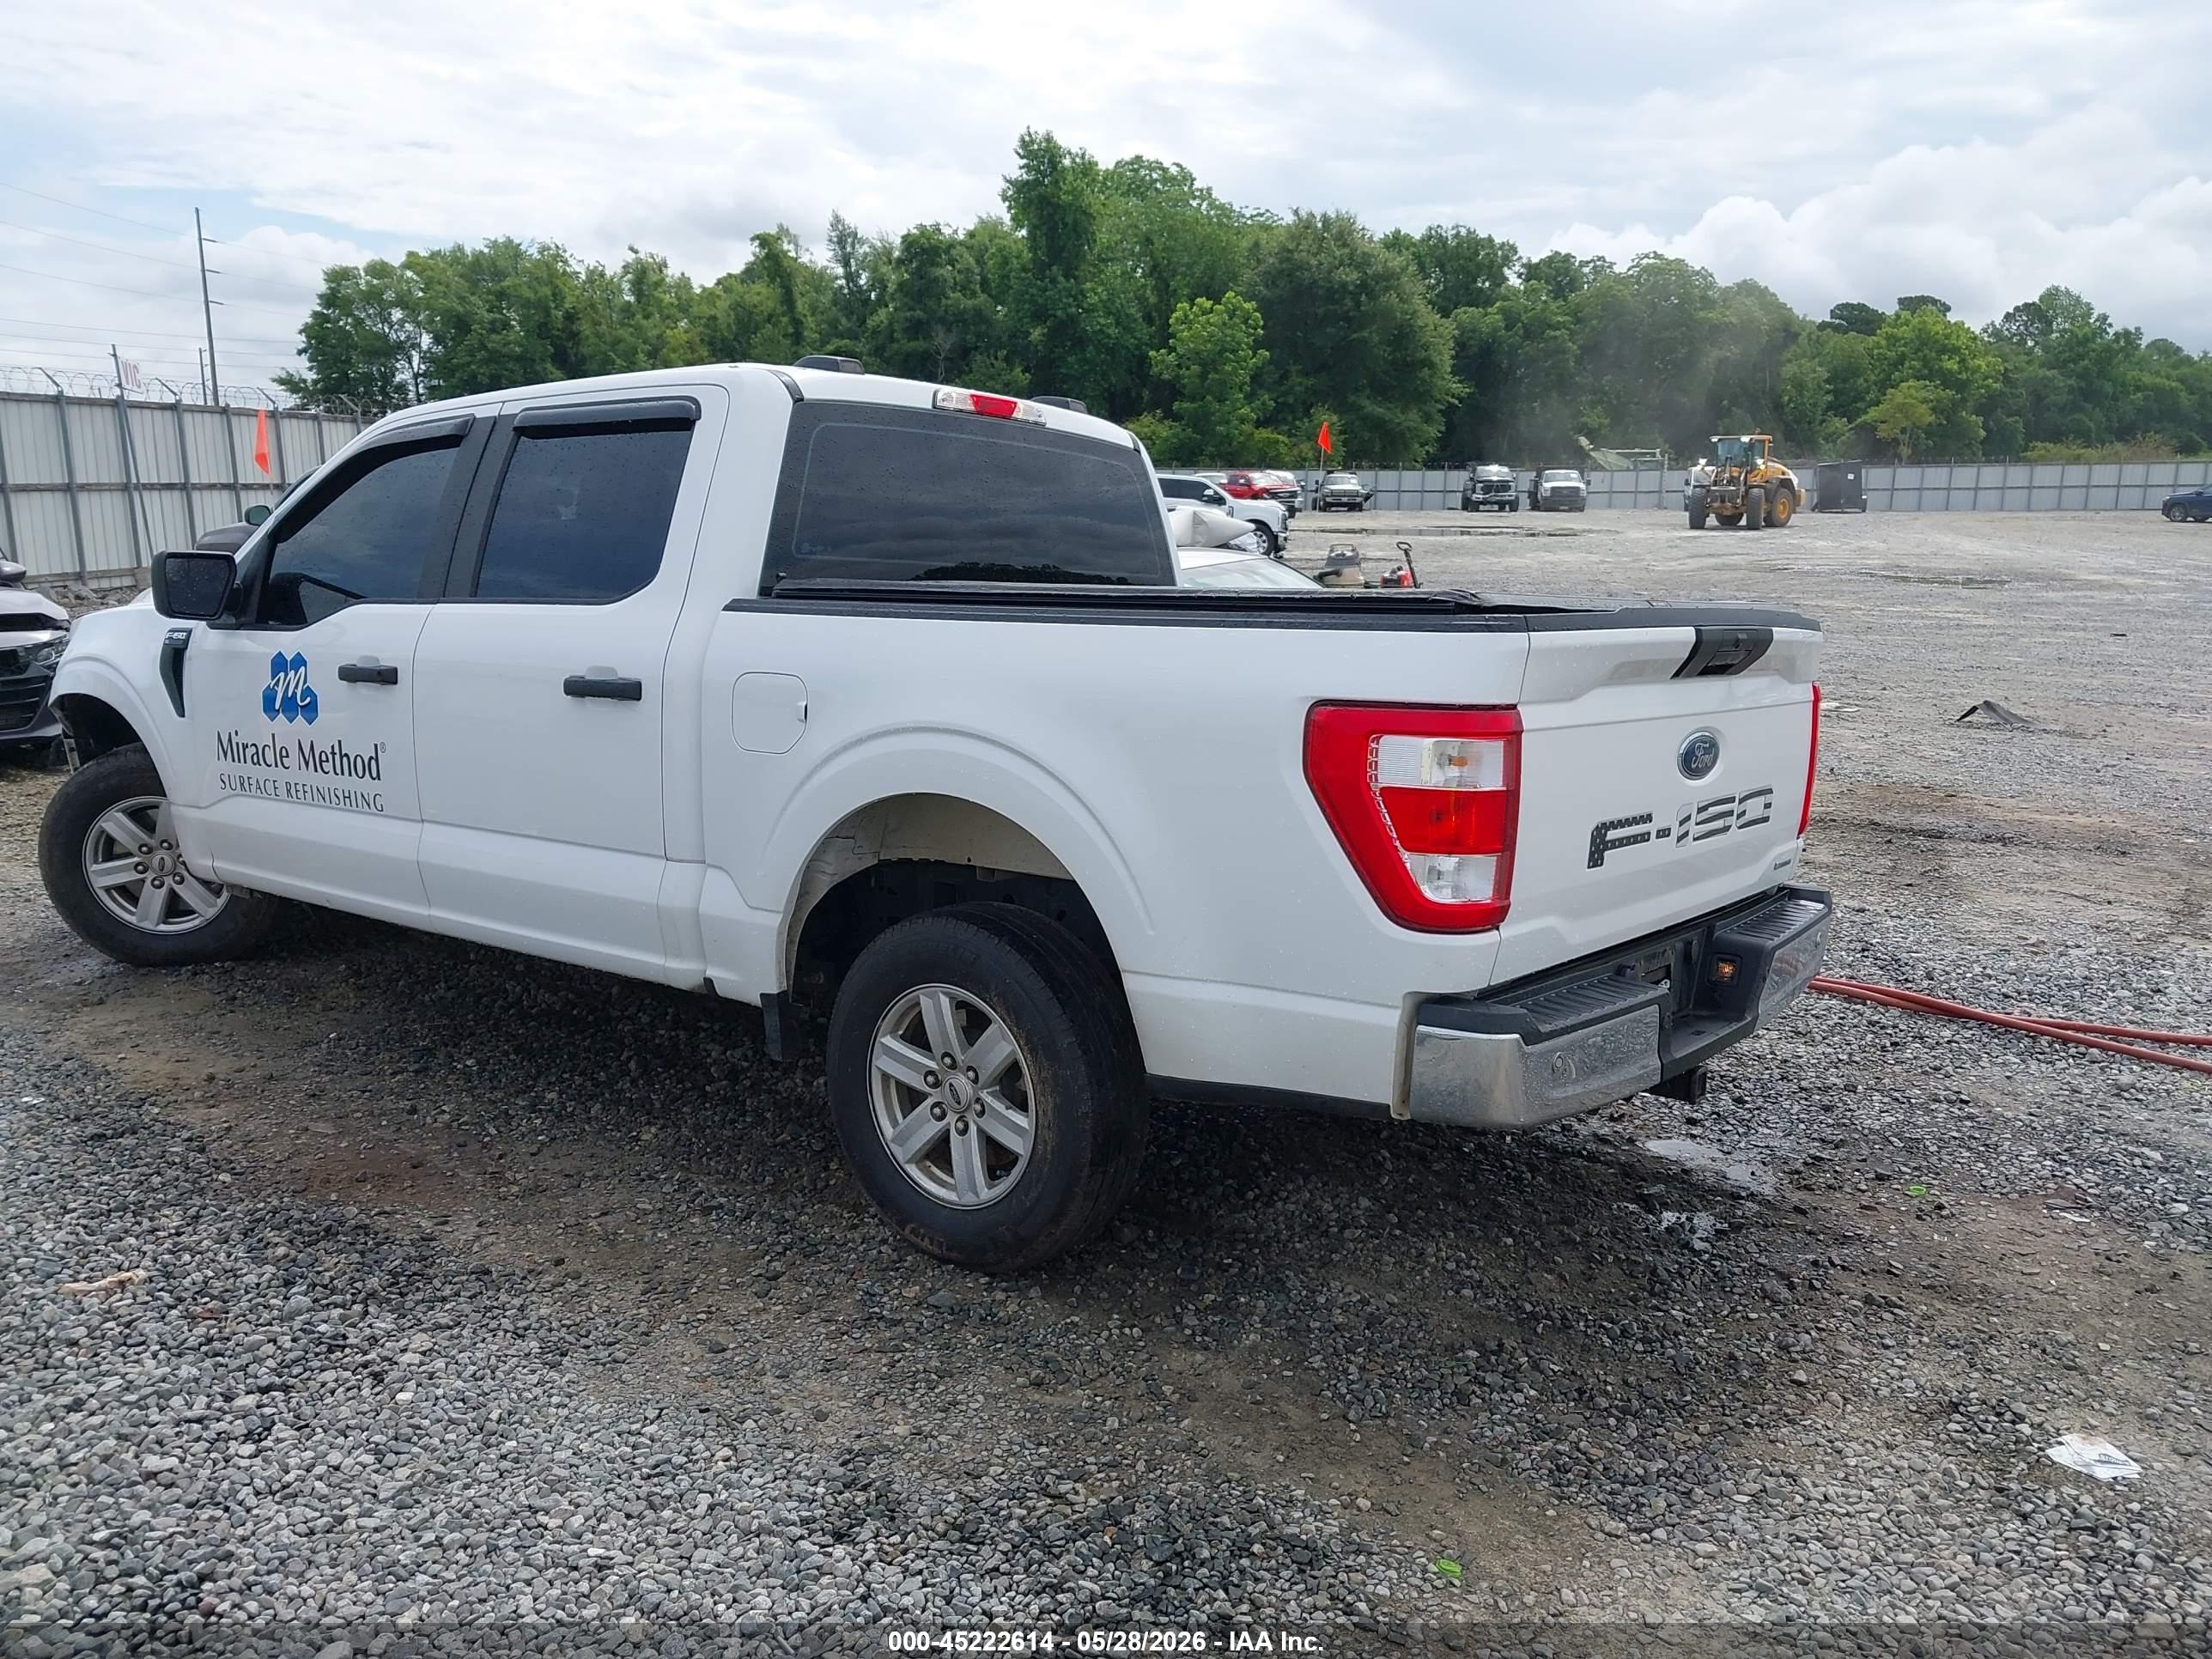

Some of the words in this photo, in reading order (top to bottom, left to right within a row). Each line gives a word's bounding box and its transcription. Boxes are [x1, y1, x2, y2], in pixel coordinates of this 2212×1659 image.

[216, 729, 291, 770] Miracle
[1691, 742, 1715, 769] Ford
[219, 773, 281, 798] SURFACE
[284, 781, 385, 812] REFINISHING
[1587, 785, 1773, 870] F-150
